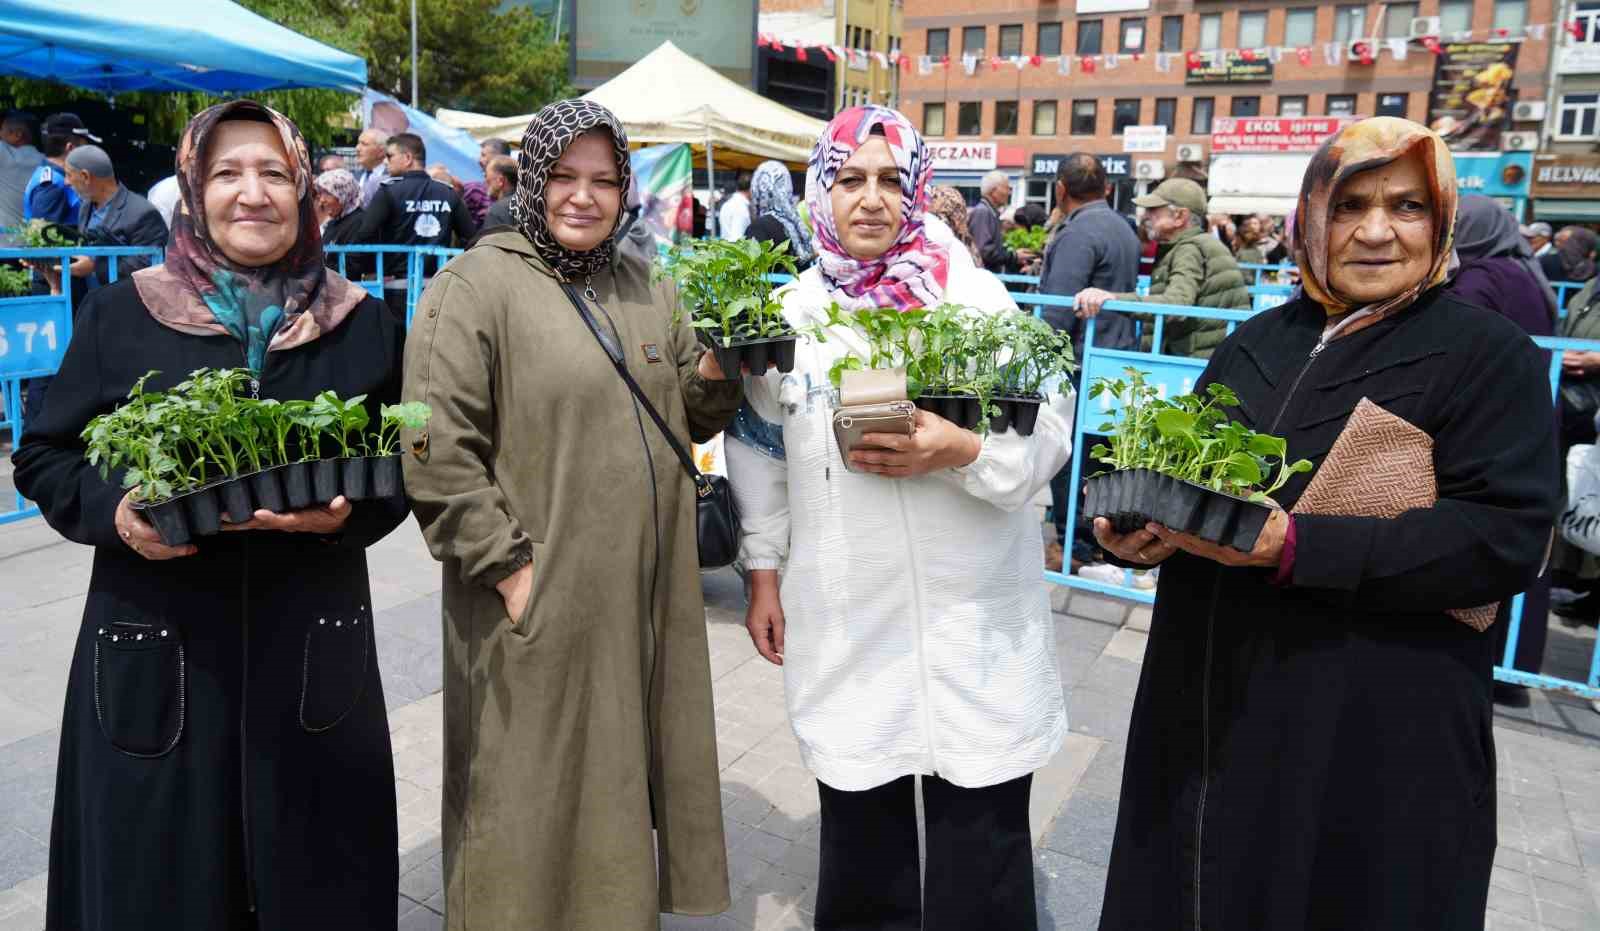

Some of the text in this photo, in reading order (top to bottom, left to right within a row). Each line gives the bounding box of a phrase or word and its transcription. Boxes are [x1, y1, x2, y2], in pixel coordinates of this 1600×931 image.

[1245, 121, 1281, 133] EKOL
[928, 147, 992, 160] ECZANE
[405, 199, 452, 213] ZABITA
[15, 319, 57, 353] 71
